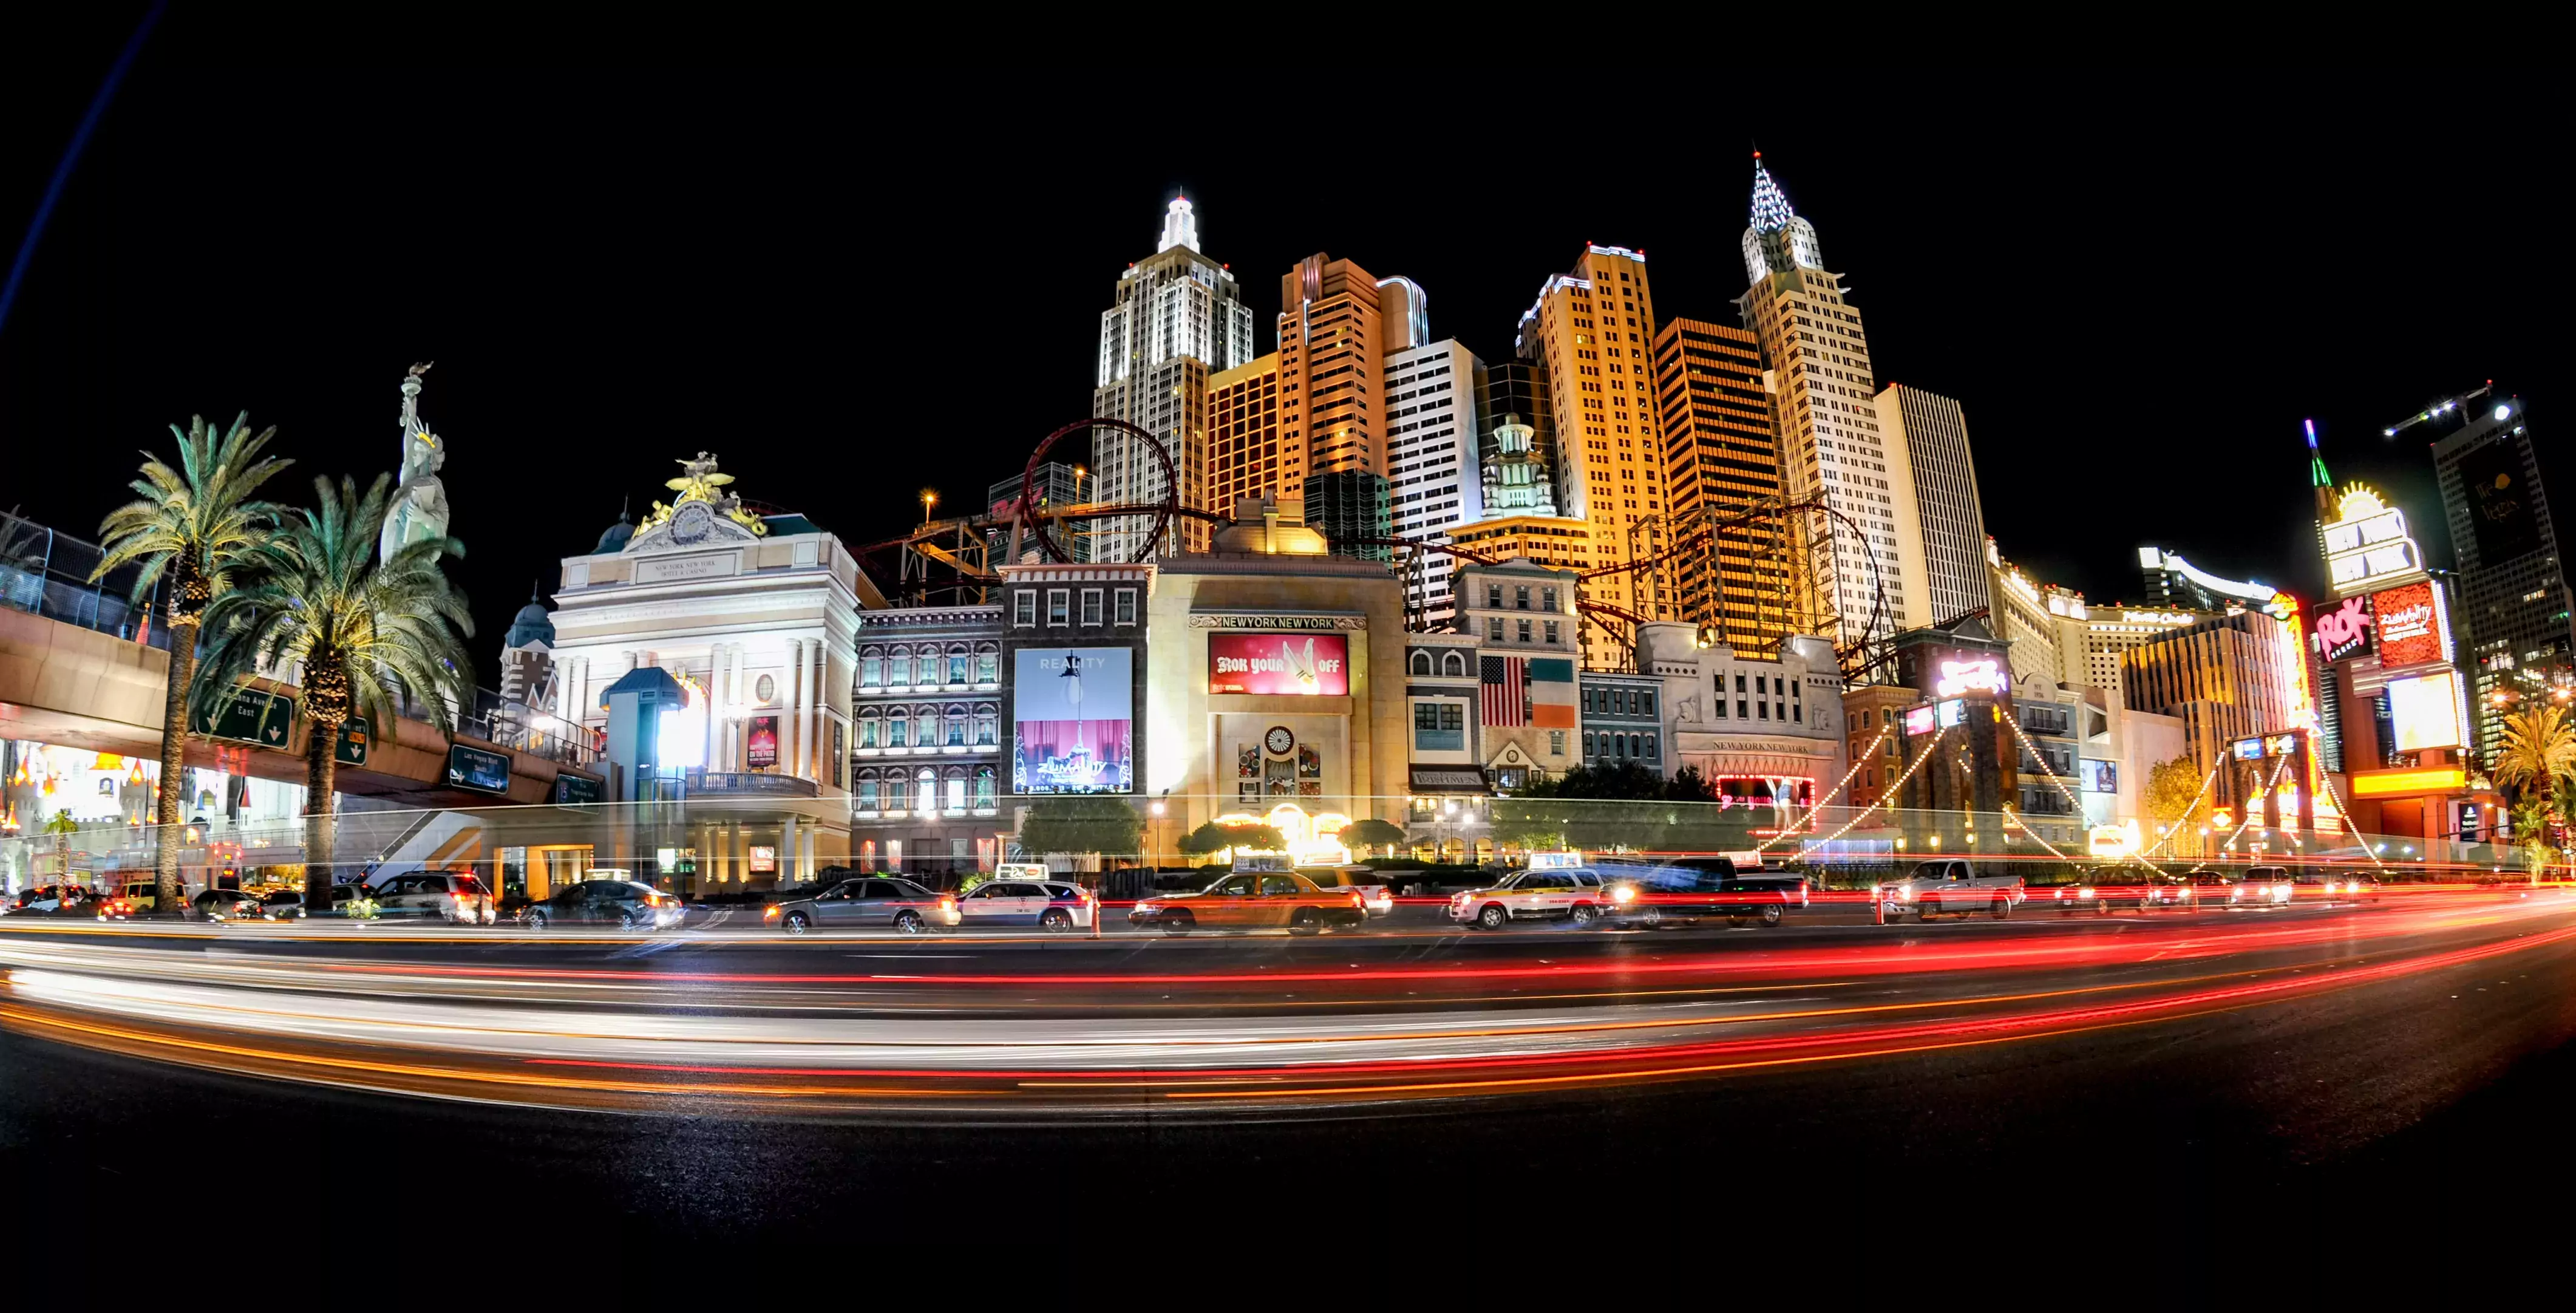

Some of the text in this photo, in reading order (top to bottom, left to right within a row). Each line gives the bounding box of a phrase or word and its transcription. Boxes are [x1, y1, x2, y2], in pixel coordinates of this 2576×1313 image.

[2381, 603, 2432, 629] ZUMANITY
[2317, 596, 2370, 663] ROK
[1040, 658, 1105, 669] REALITY
[253, 697, 277, 709] Aveue
[238, 706, 254, 717] East
[1738, 742, 1765, 751] YORK
[1787, 745, 1809, 753] YORK
